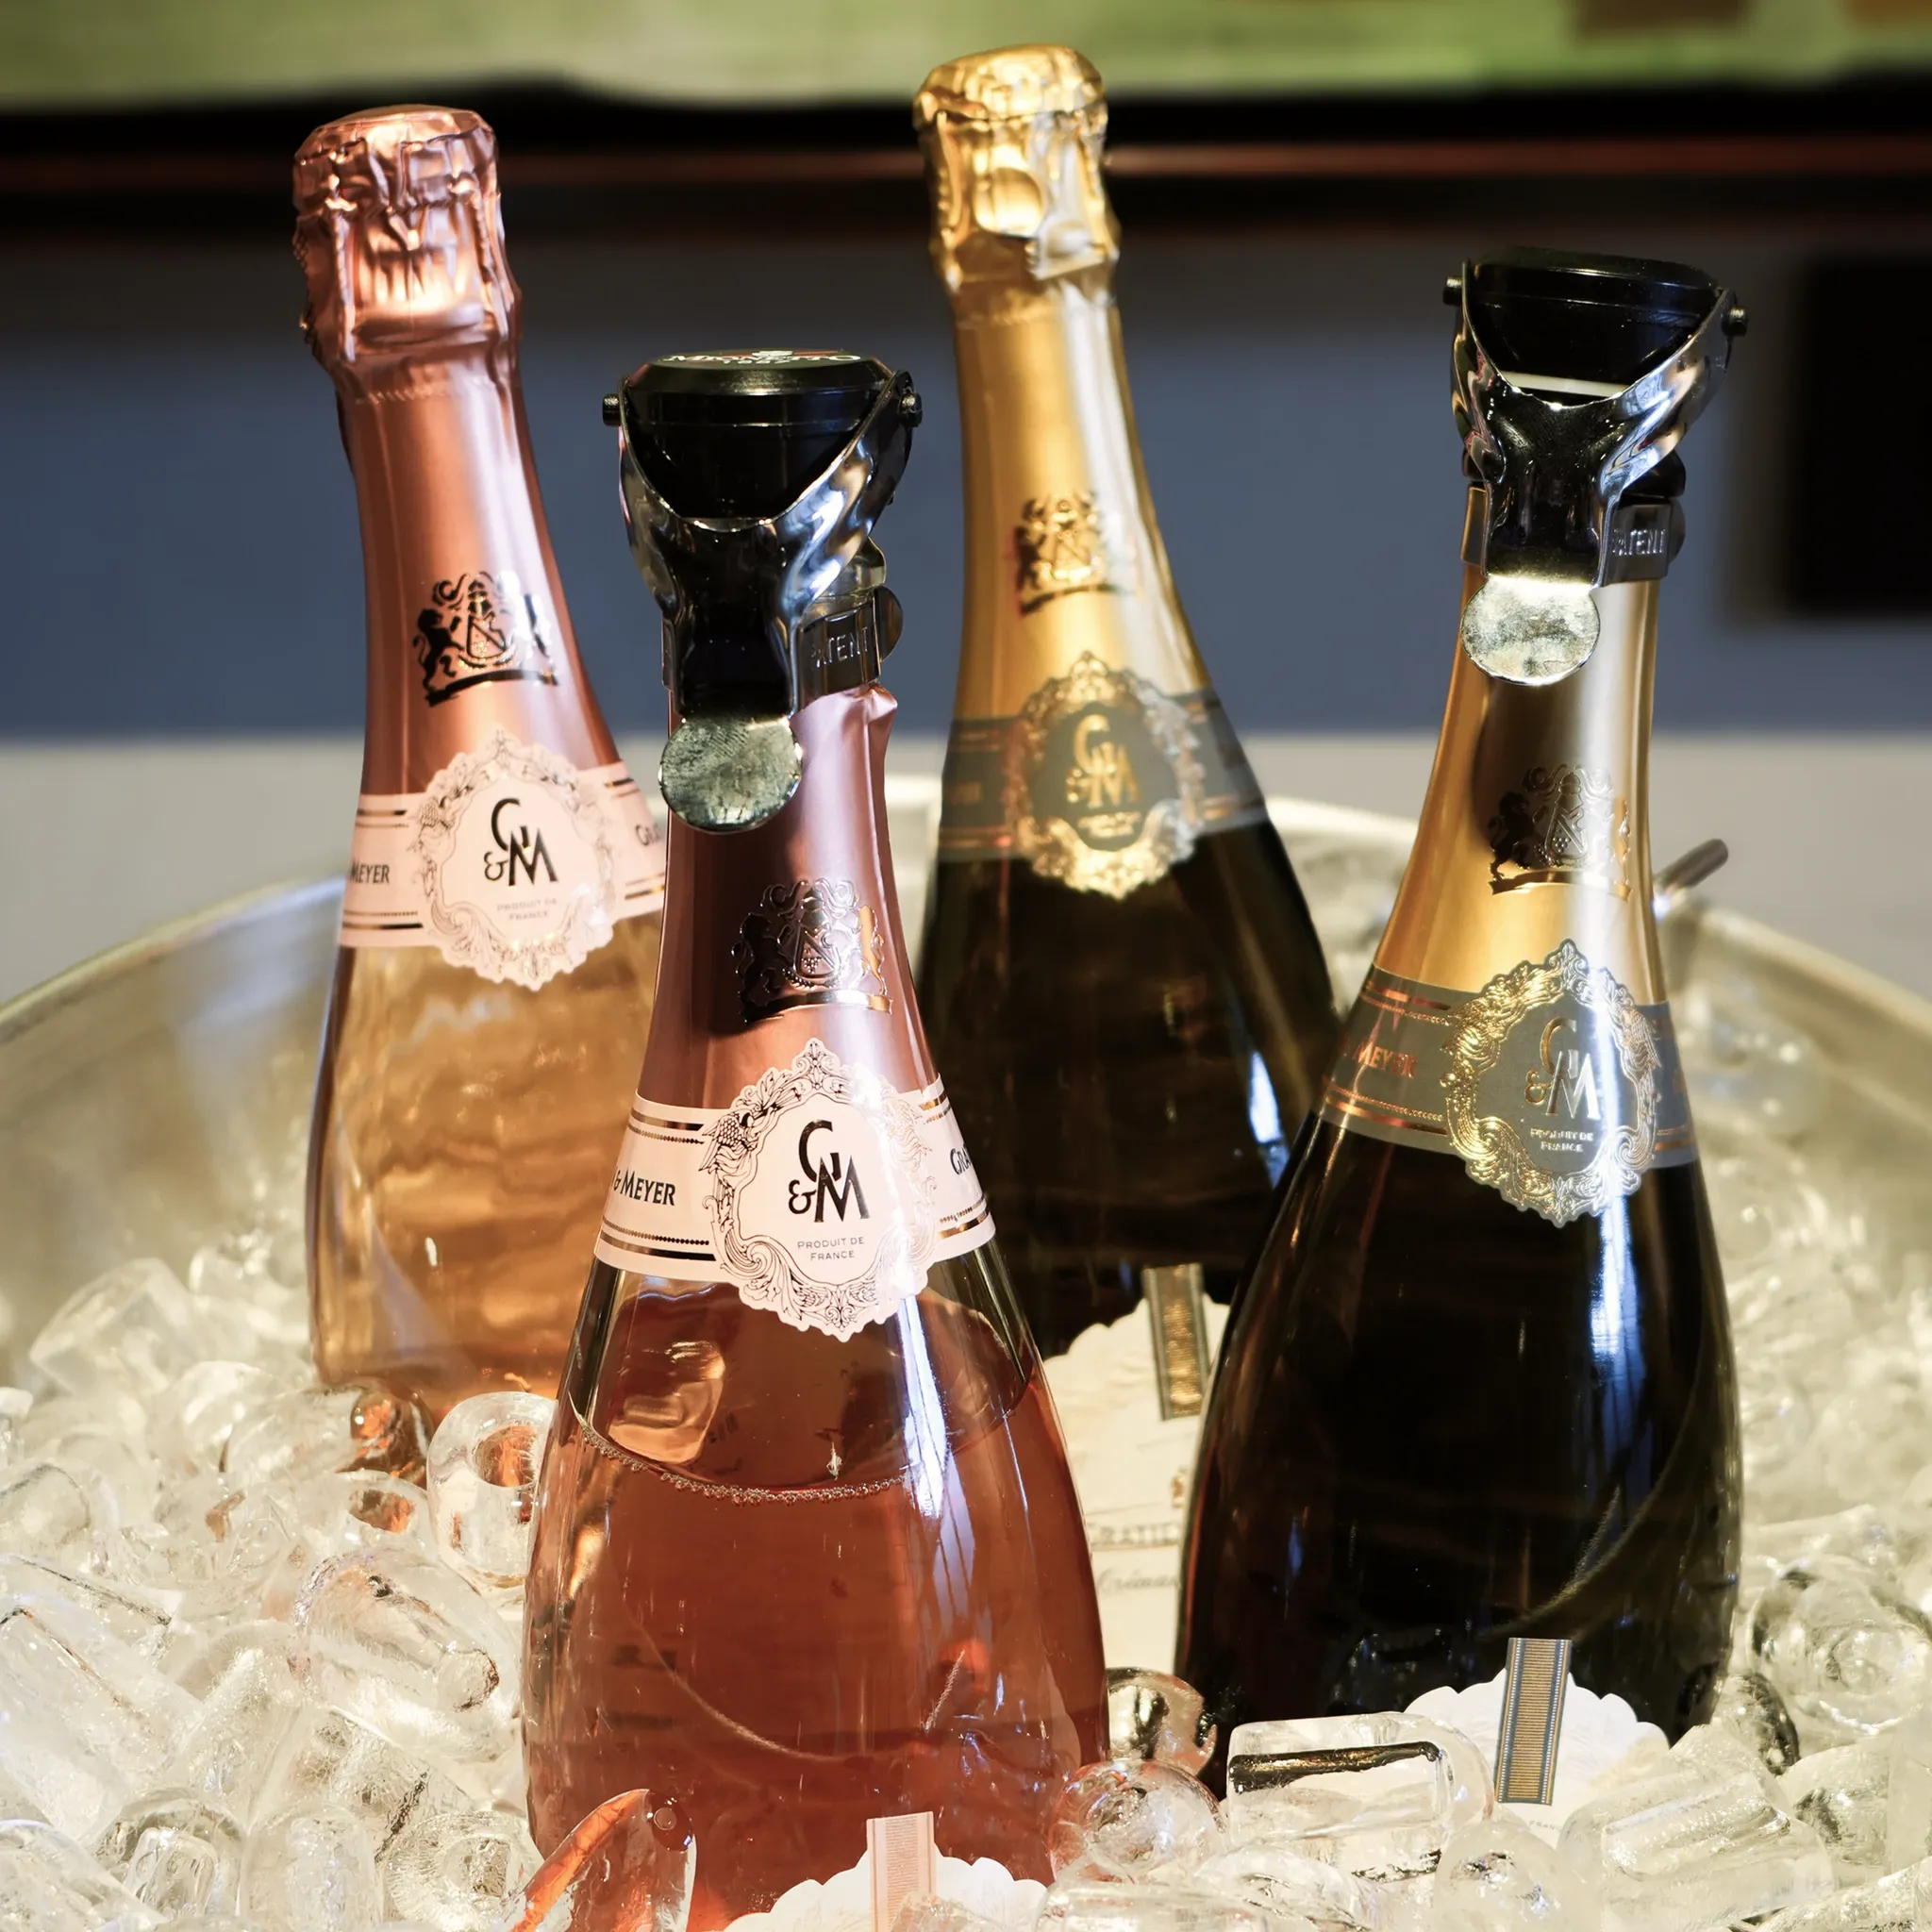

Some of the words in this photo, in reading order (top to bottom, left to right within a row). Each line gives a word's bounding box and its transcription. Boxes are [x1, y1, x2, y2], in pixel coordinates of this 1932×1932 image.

[620, 1168, 676, 1207] MEYER
[796, 1238, 846, 1250] PRODUIT
[850, 1237, 864, 1245] DE
[810, 1250, 856, 1261] FRANCE
